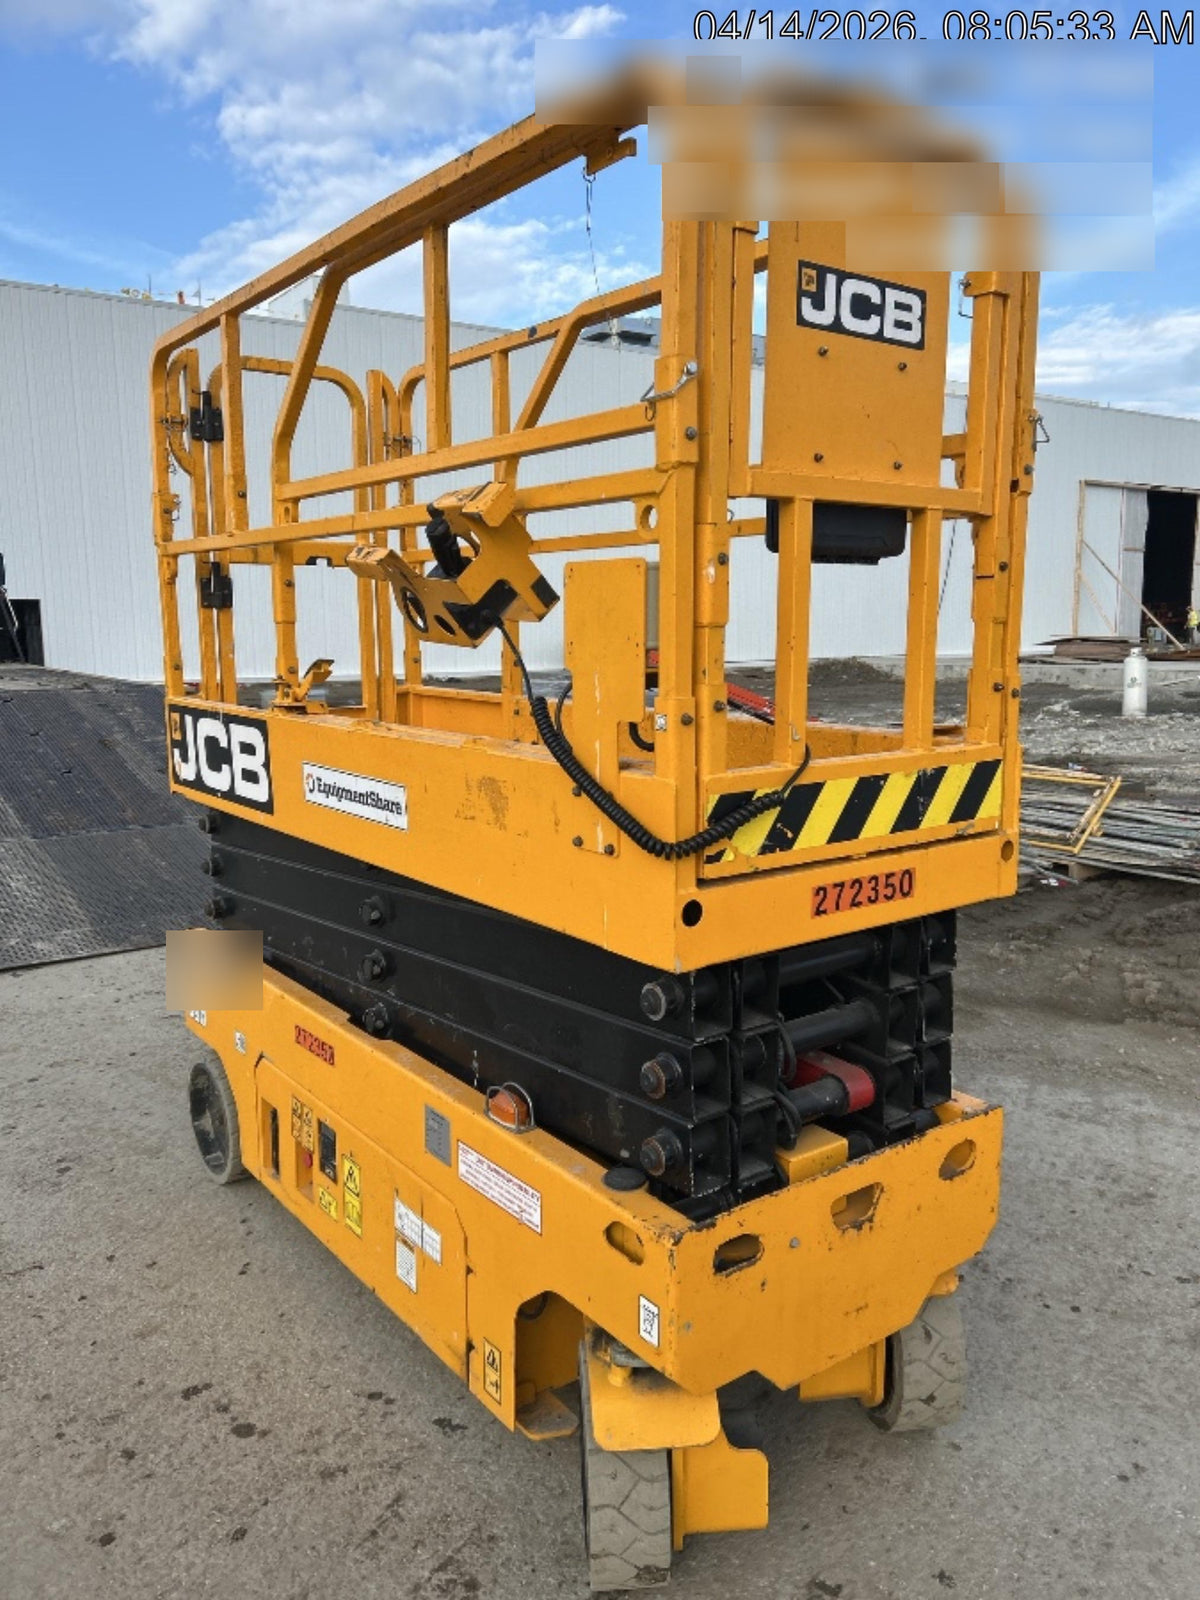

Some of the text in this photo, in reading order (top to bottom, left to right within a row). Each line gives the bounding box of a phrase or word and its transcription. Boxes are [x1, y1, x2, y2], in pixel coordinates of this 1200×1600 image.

[801, 272, 922, 344] JCB
[173, 714, 269, 803] JCB
[316, 776, 403, 816] EquipmentShare
[814, 868, 913, 916] 272350
